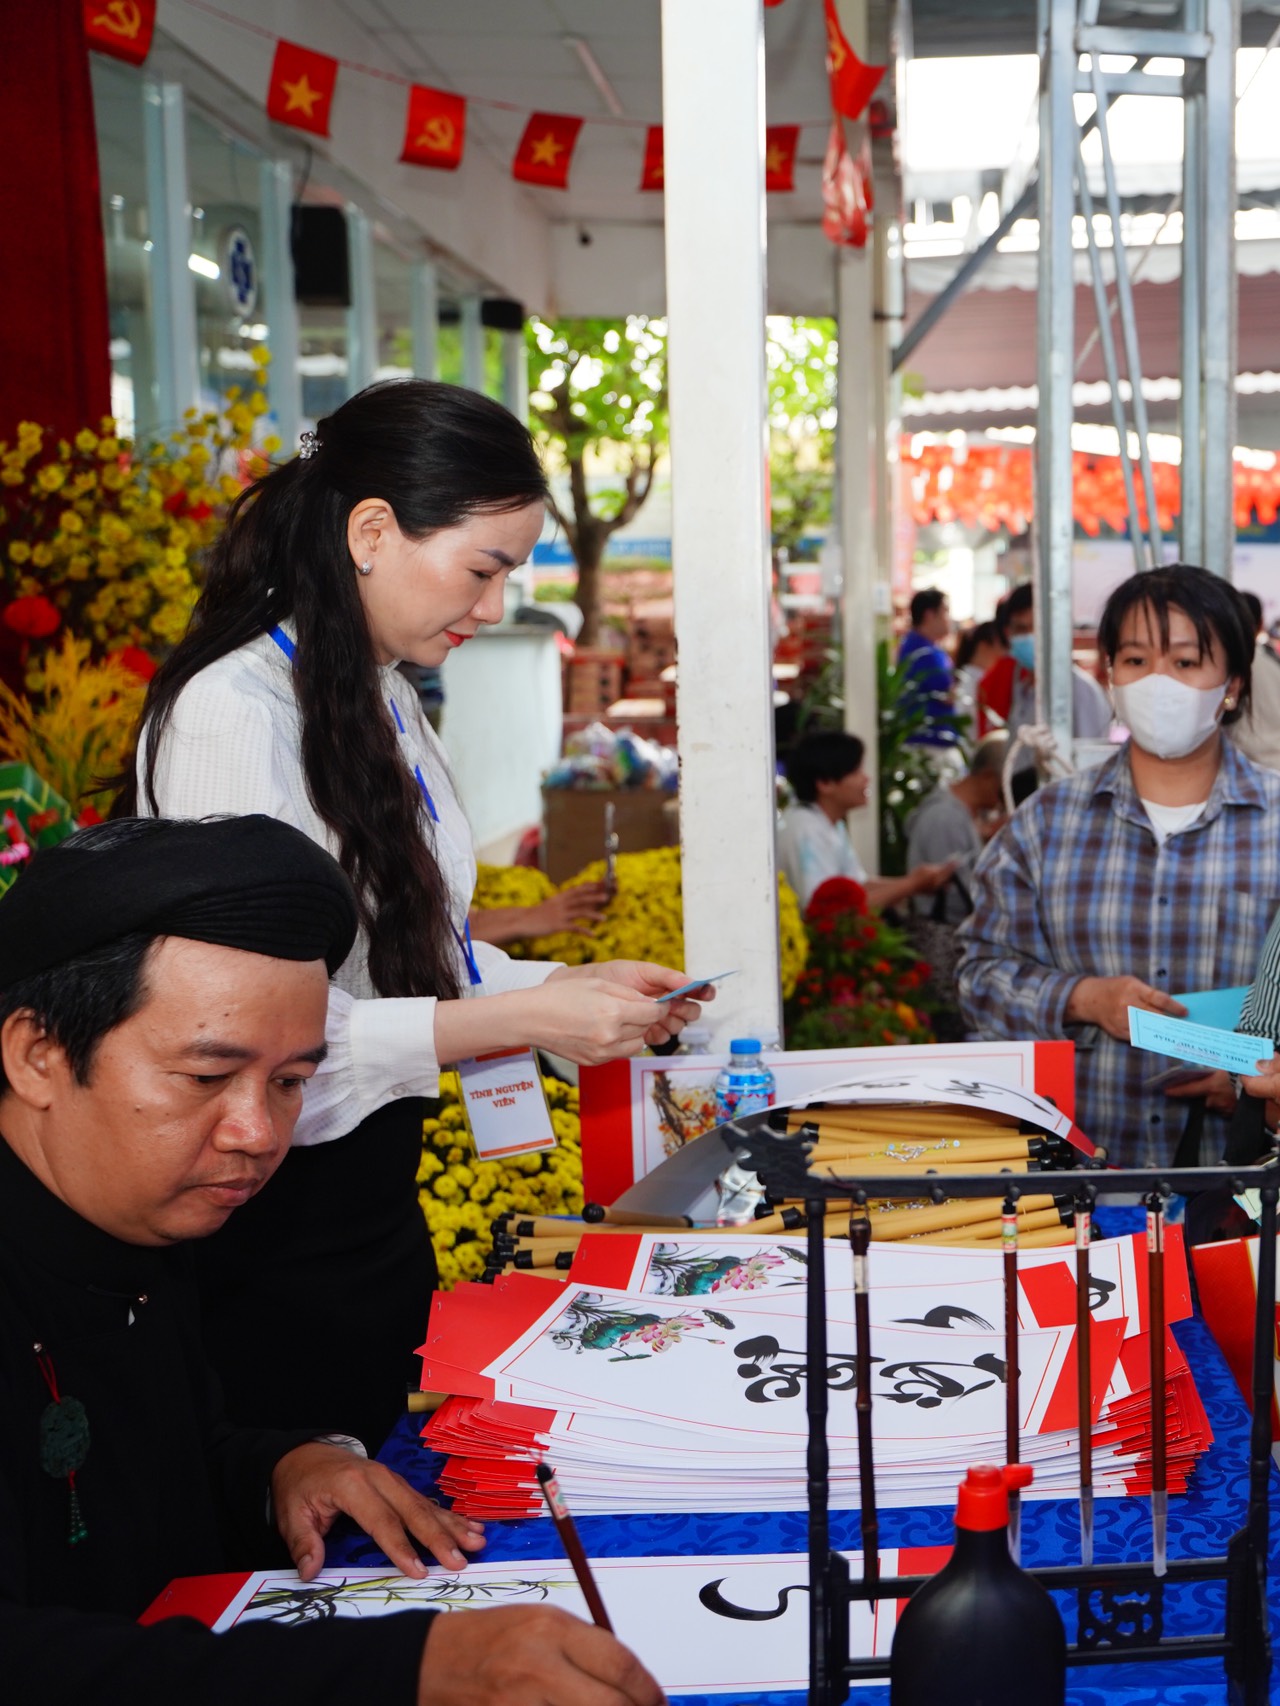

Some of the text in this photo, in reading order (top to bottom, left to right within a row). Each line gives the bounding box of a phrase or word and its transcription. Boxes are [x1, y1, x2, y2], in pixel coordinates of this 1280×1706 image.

[469, 1081, 534, 1100] TÌNH NGUYỆN
[493, 1097, 516, 1108] VIÊN
